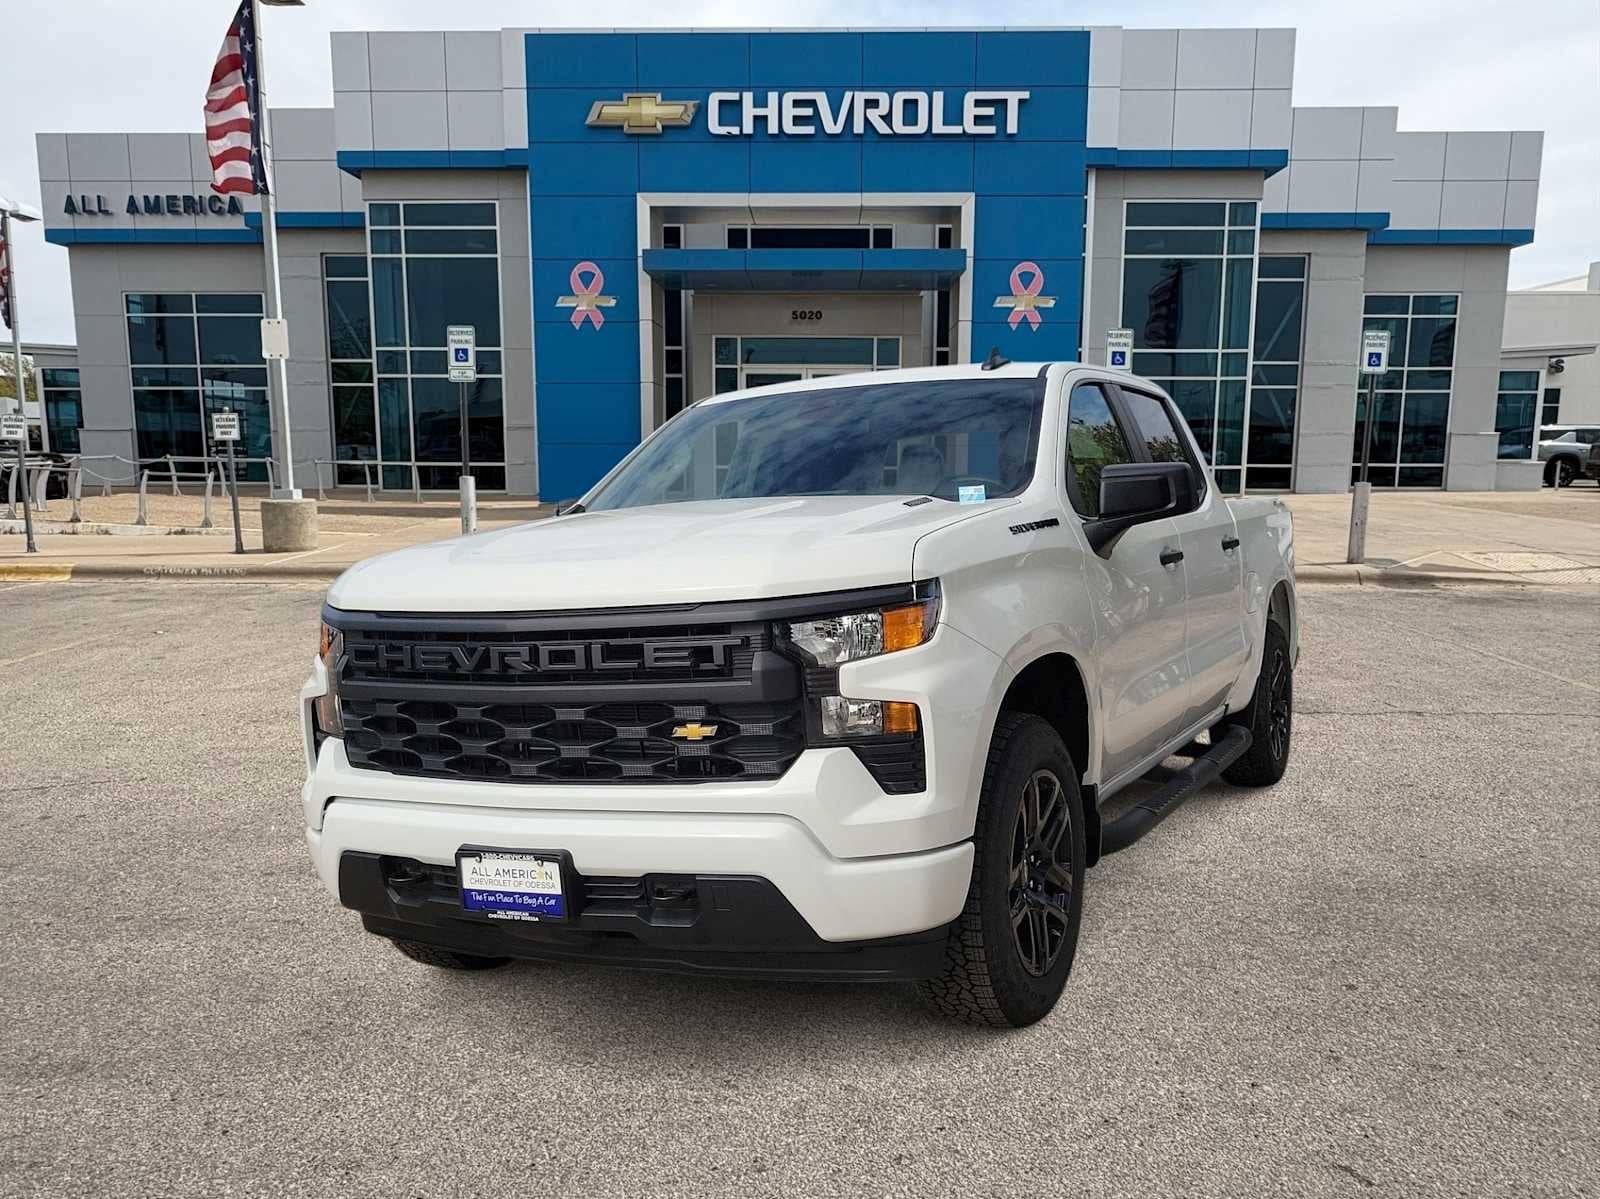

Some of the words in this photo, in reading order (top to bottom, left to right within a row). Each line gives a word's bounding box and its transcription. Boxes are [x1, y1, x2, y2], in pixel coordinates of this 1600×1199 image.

[707, 90, 1030, 135] CHEVROLET
[64, 194, 112, 215] ALL
[791, 310, 823, 320] 5020
[1008, 517, 1060, 535] SILVER
[347, 636, 749, 673] CHEVROLET
[471, 866, 491, 877] ALL
[470, 878, 512, 888] CHEVROLET
[525, 880, 556, 889] ODESSA
[471, 891, 484, 901] The
[483, 892, 496, 902] Fun
[496, 893, 514, 904] Place
[513, 894, 522, 904] To
[537, 897, 544, 905] A
[544, 897, 556, 905] Car
